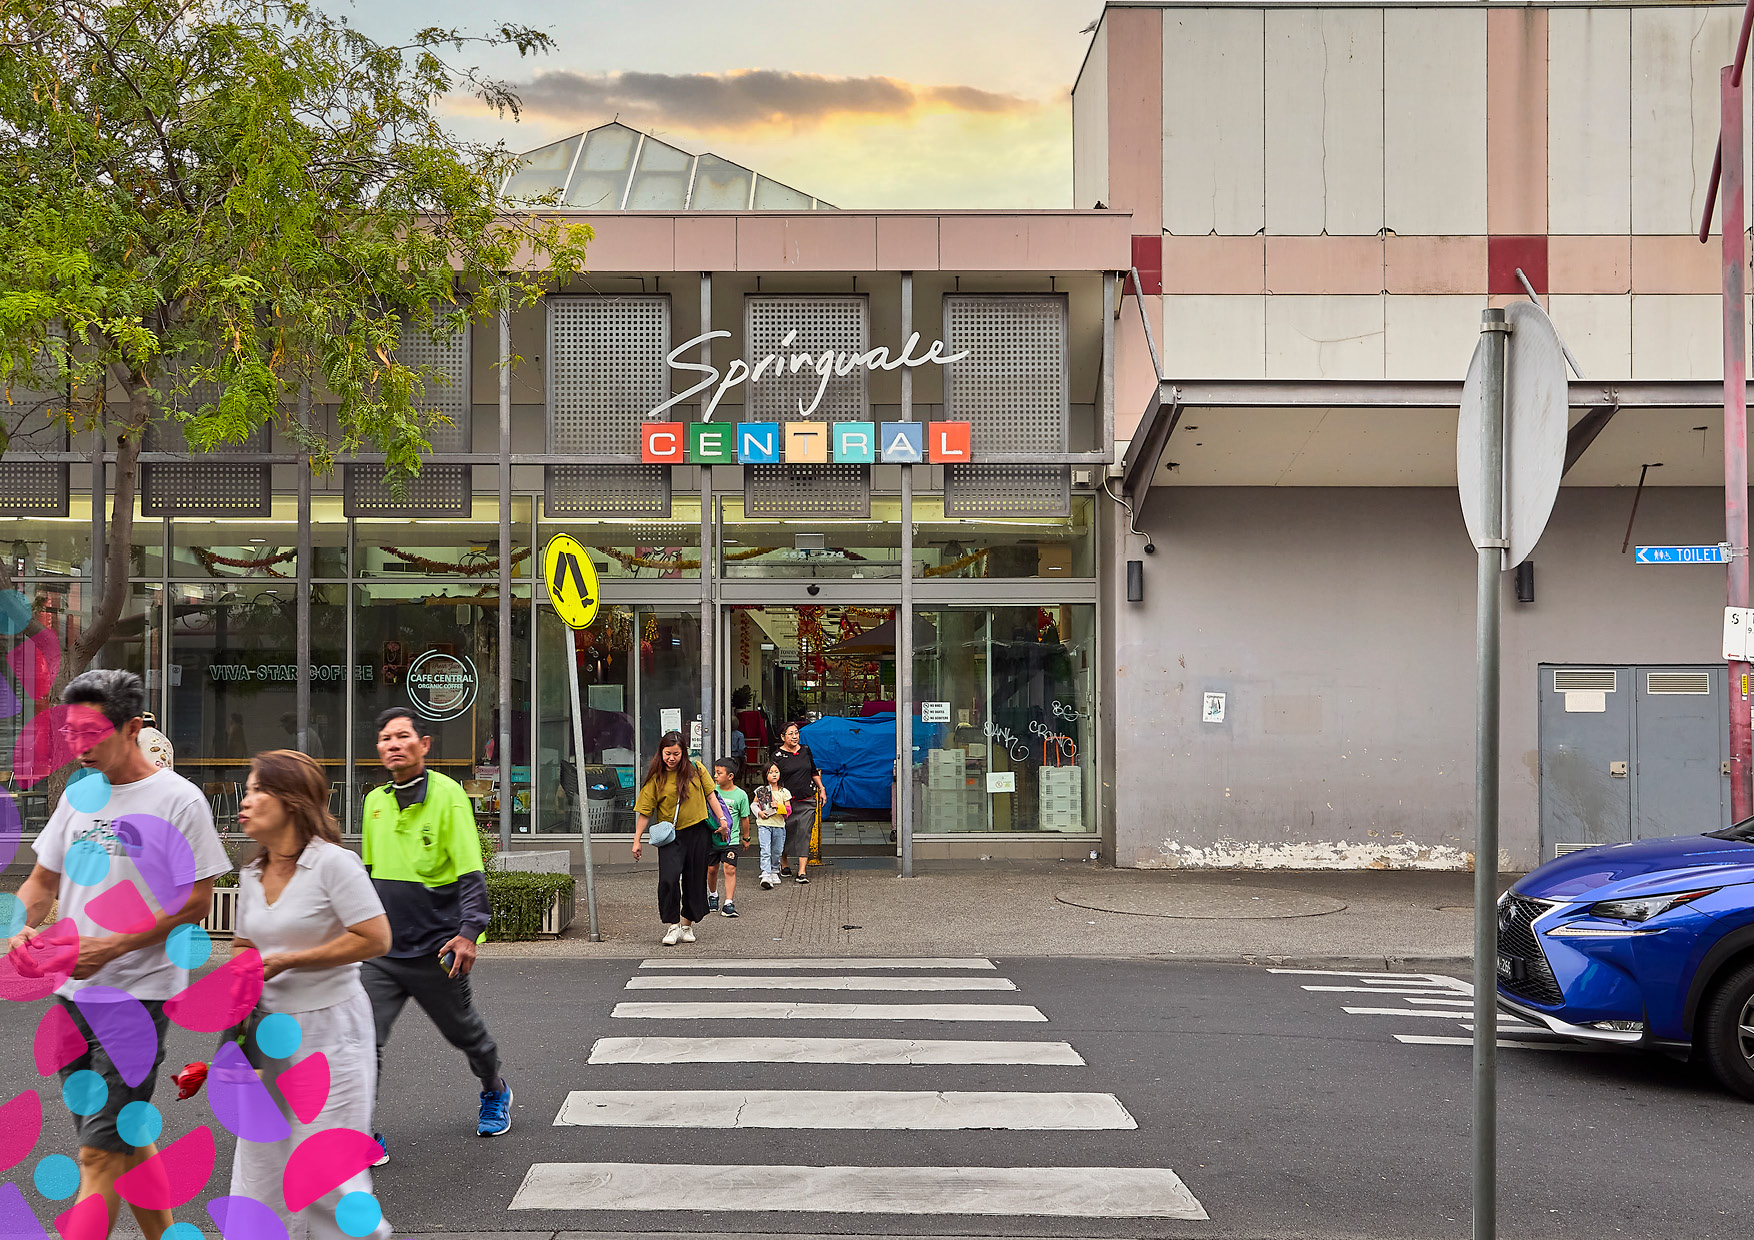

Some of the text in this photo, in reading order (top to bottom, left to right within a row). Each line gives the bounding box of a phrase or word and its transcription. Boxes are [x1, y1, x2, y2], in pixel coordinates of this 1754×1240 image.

[648, 329, 970, 423] Springvale
[648, 431, 963, 456] CENTRAL
[1676, 548, 1718, 561] TOILET
[410, 674, 474, 683] CAFE CENTRAL
